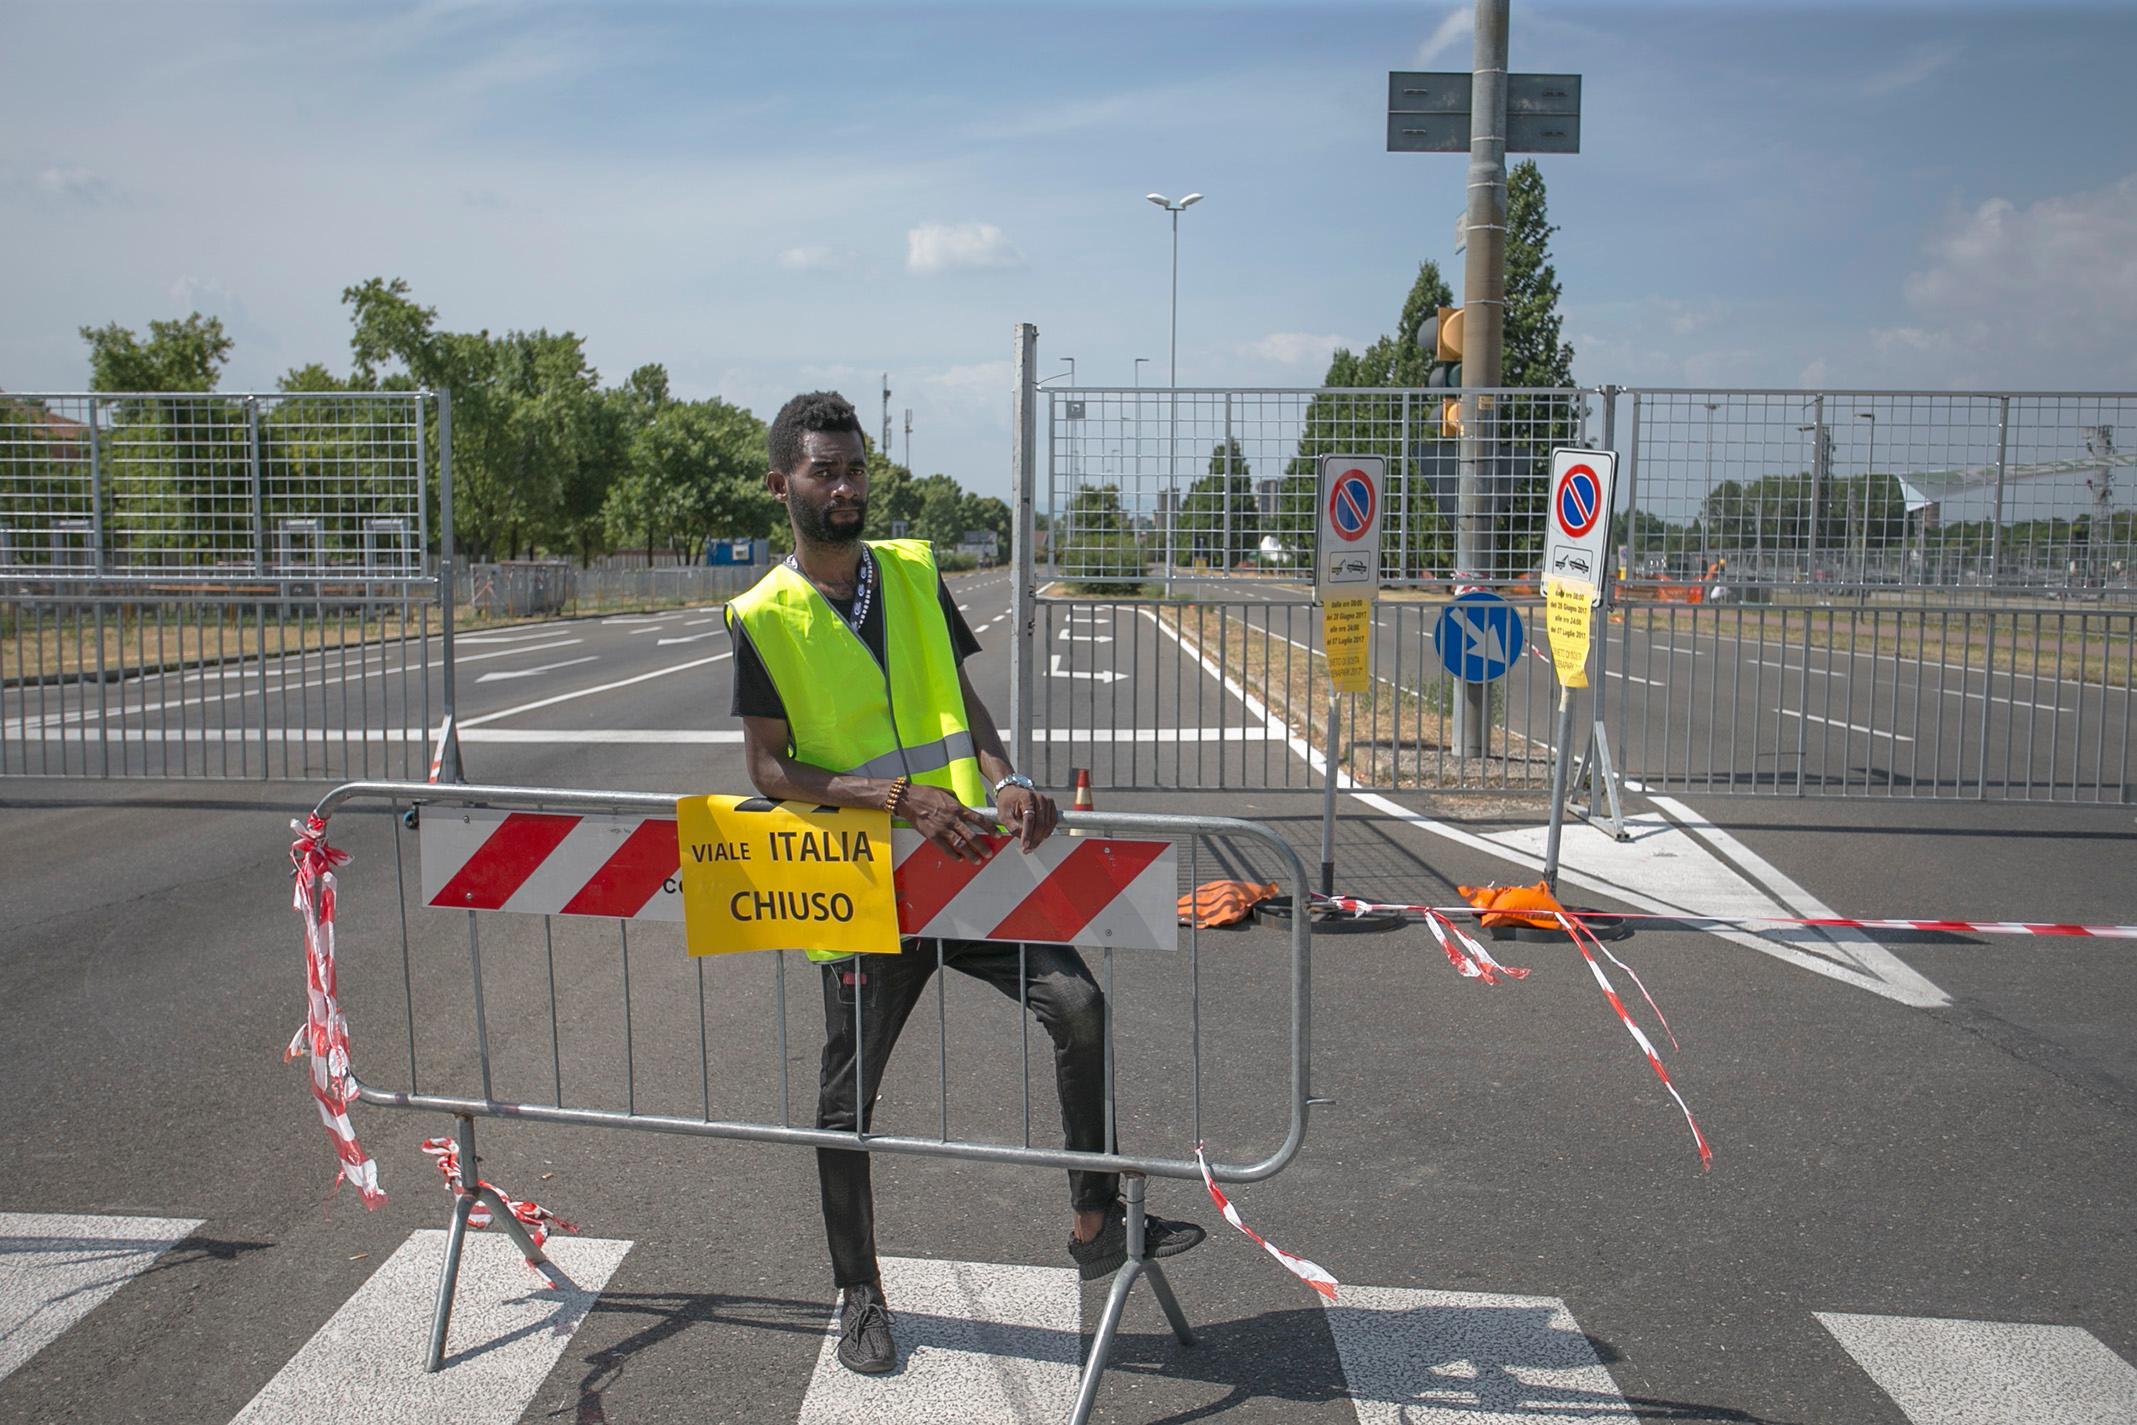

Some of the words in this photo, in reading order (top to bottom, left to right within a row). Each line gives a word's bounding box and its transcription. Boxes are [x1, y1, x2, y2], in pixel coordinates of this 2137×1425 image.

[691, 842, 752, 863] VIALE
[768, 831, 875, 863] ITALIA
[730, 890, 854, 923] CHIUSO
